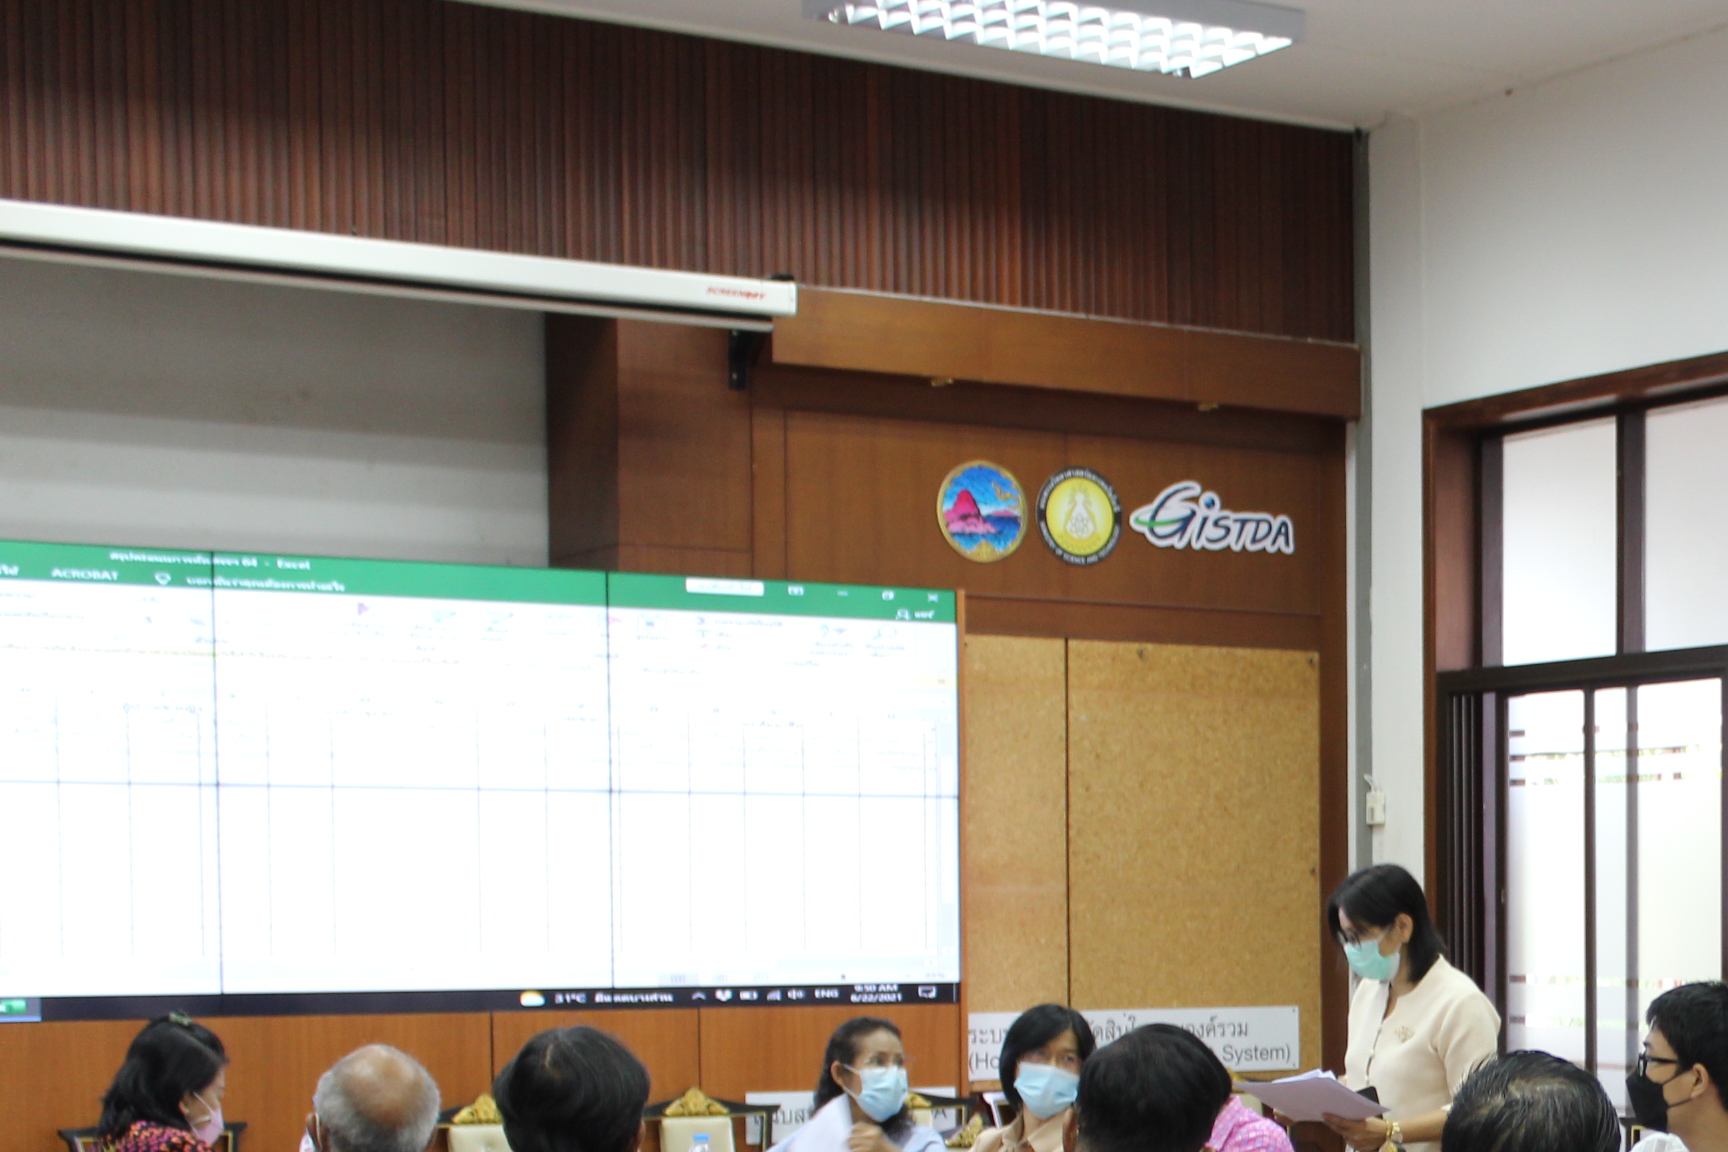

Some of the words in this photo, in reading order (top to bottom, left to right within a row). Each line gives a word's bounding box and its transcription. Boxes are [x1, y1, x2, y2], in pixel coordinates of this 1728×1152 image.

[277, 558, 311, 571] Excel
[52, 568, 118, 581] ACROBAT
[815, 988, 839, 999] ENG
[878, 984, 898, 992] AM
[1222, 1044, 1291, 1065] System)
